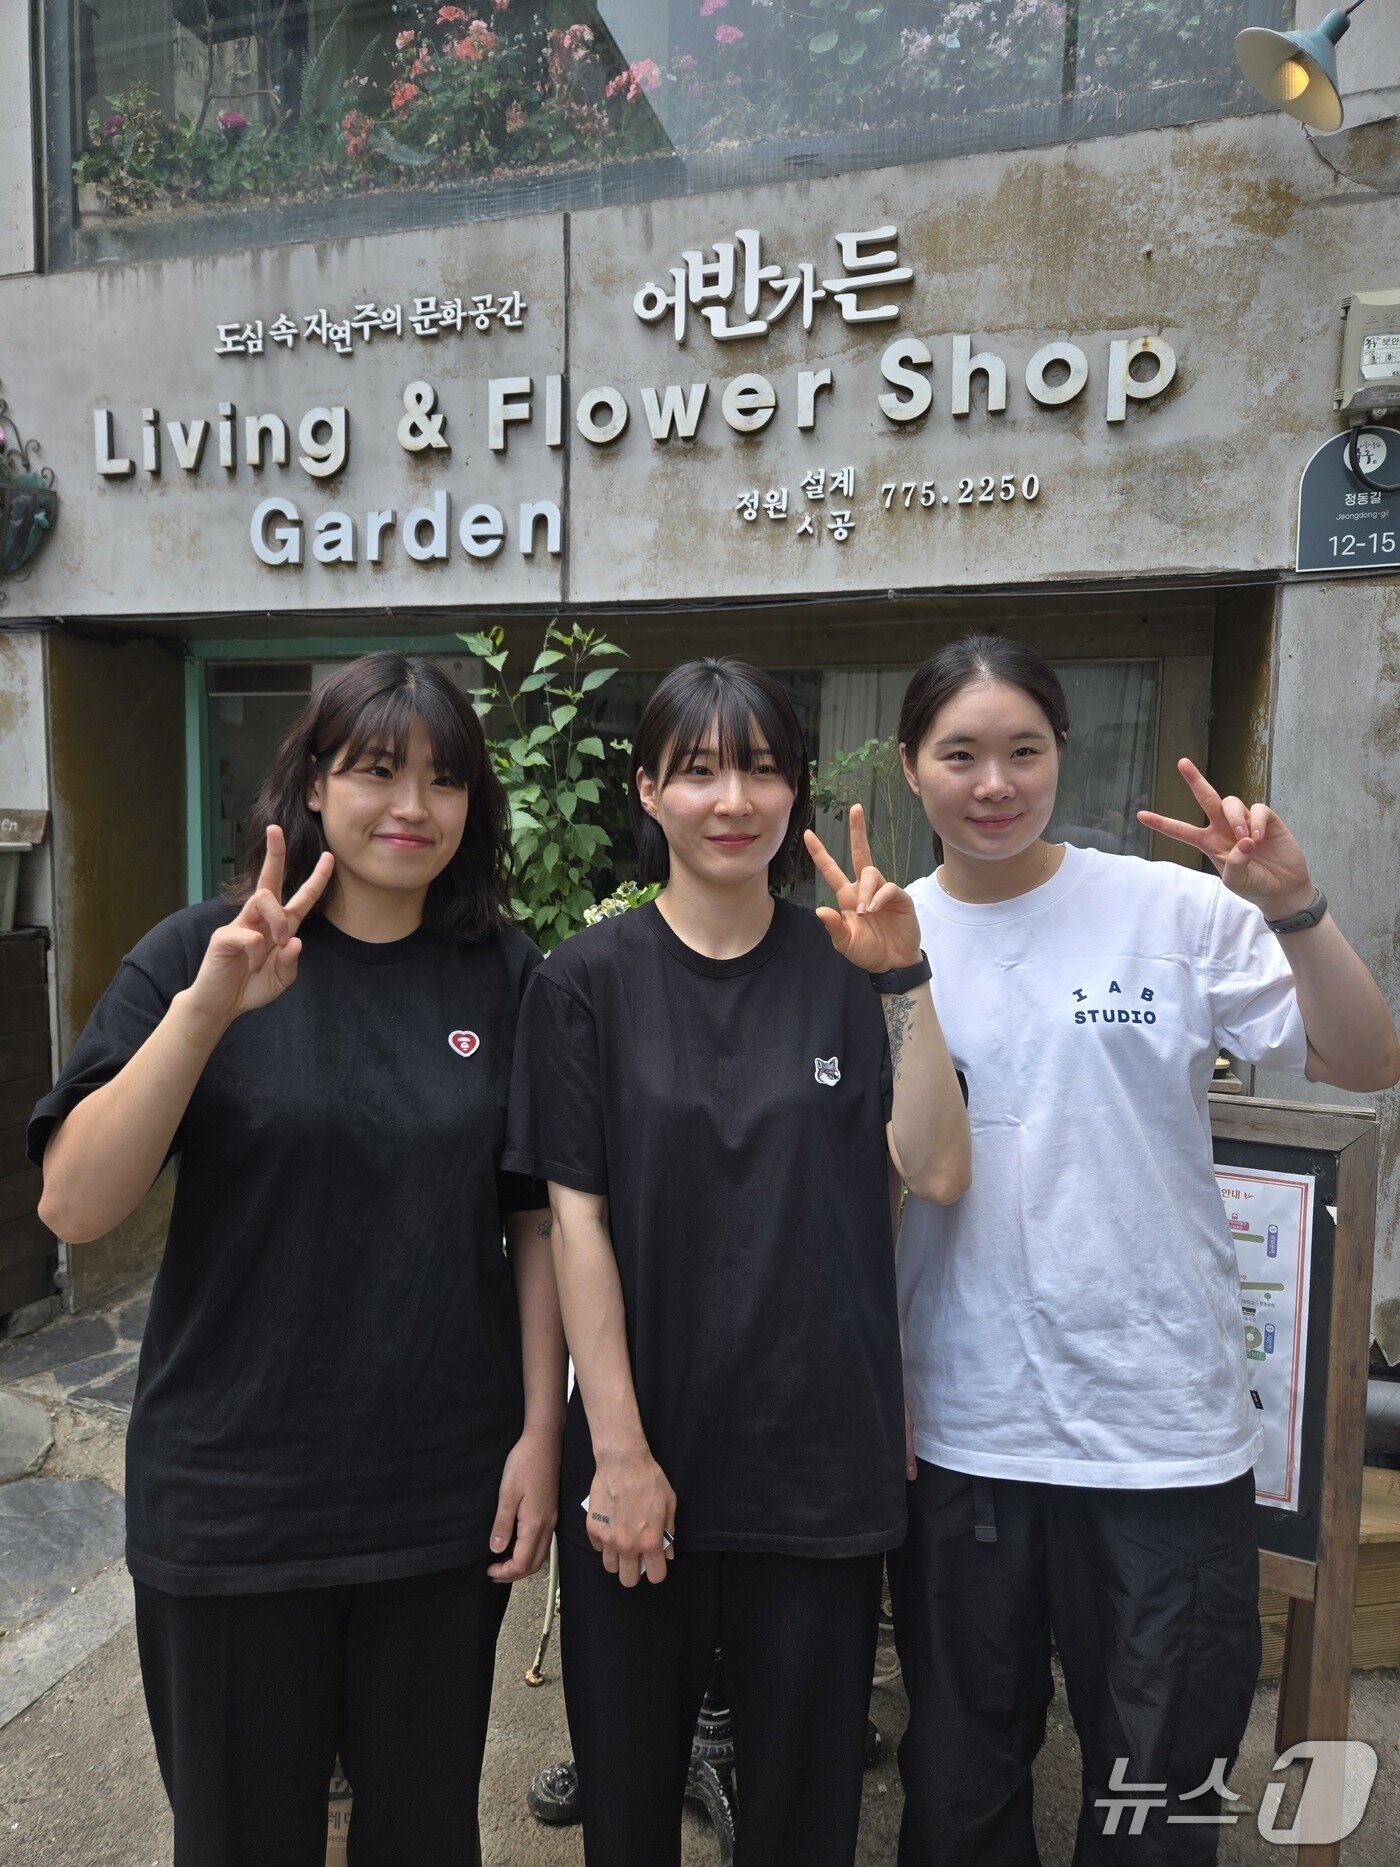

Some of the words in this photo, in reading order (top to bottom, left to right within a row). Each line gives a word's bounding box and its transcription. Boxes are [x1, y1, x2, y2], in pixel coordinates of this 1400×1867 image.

[632, 225, 914, 344] 어반가든
[213, 320, 264, 354] 도심
[268, 313, 299, 349] 속
[303, 303, 402, 354] 자연주의
[408, 290, 527, 337] 문화공간
[93, 401, 350, 478] Living
[397, 380, 451, 452] &
[488, 367, 833, 451] Flower
[877, 333, 1178, 423] Shop
[734, 487, 789, 521] 정원
[800, 466, 855, 500] 설계
[881, 473, 1041, 509] 775.2250
[1344, 491, 1382, 506] 정동길
[249, 490, 563, 567] Garden
[1335, 509, 1390, 521] Jeongdong-gil
[1328, 532, 1396, 557] 12-15
[1074, 1009, 1157, 1025] STUDIO
